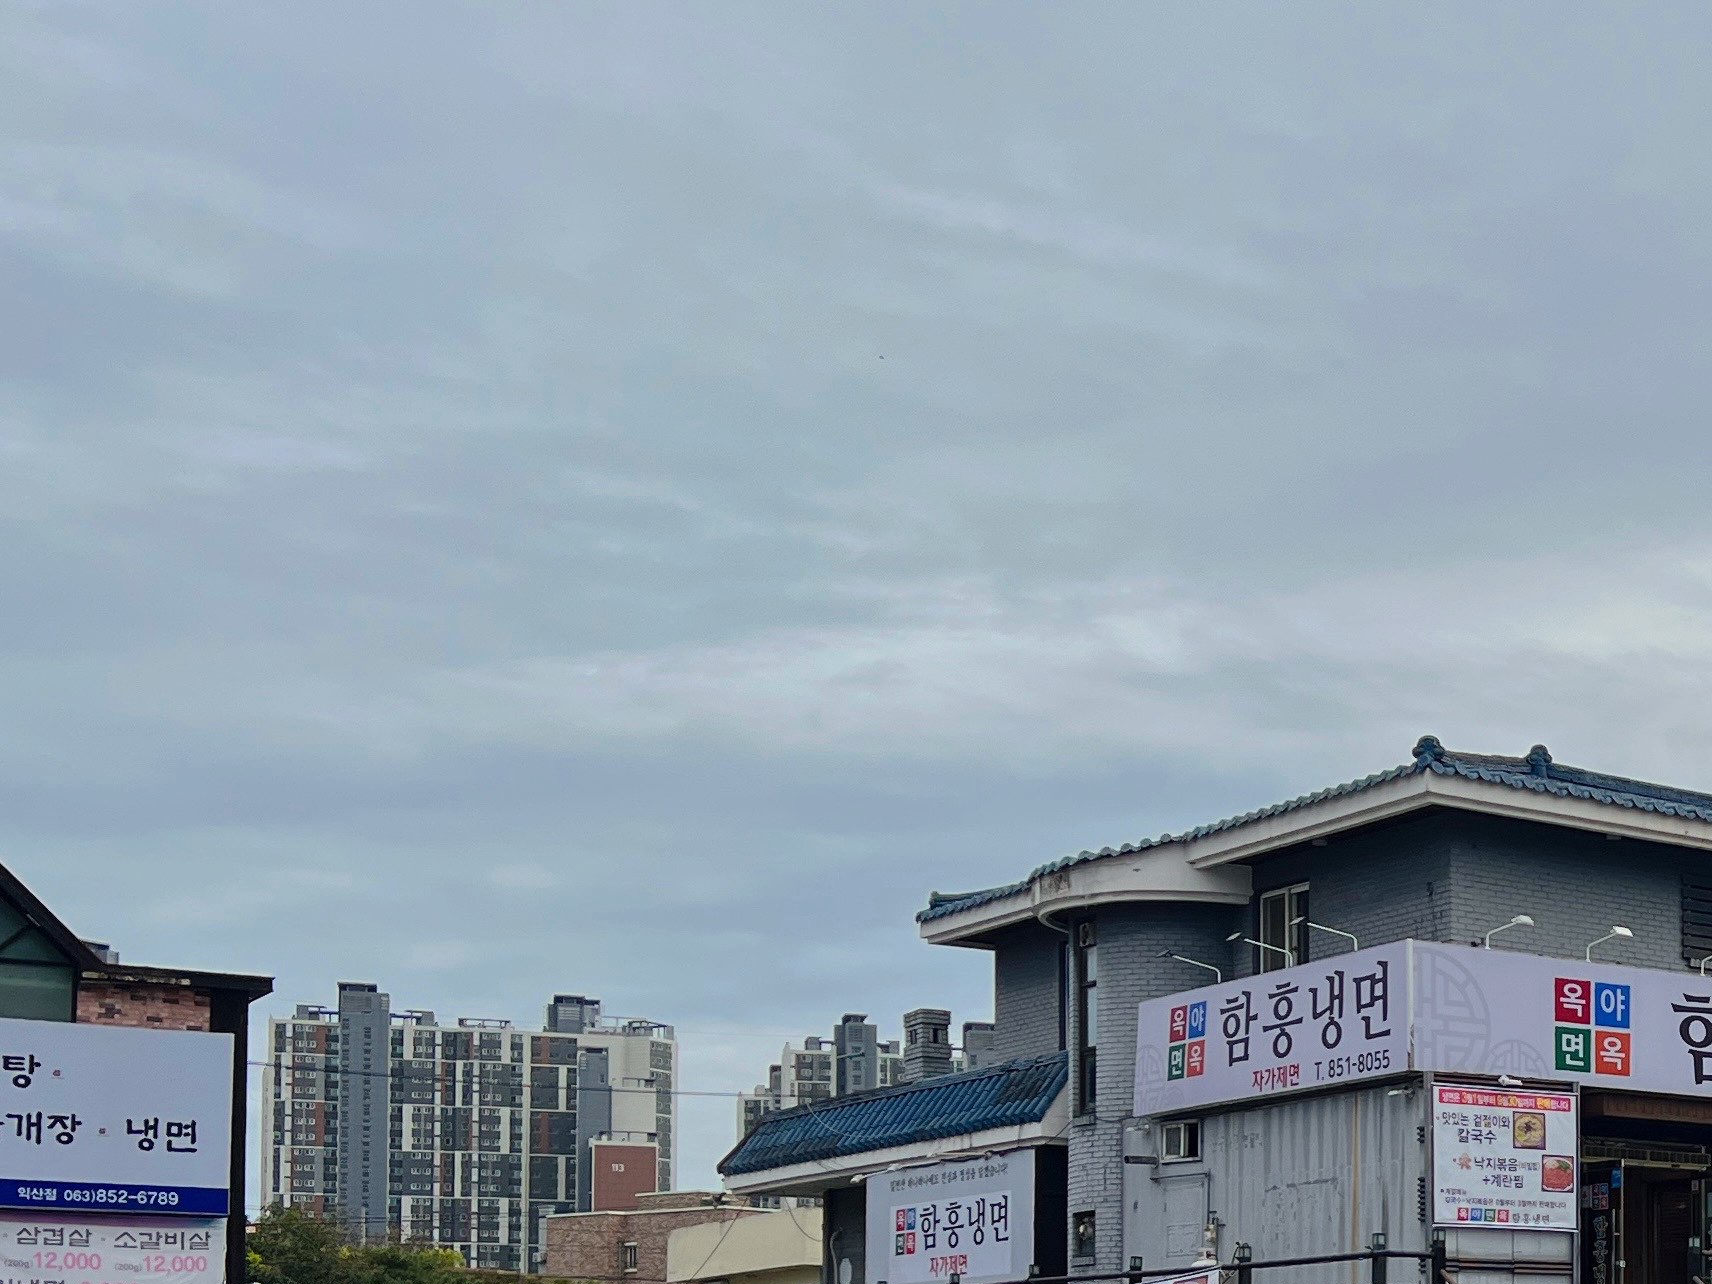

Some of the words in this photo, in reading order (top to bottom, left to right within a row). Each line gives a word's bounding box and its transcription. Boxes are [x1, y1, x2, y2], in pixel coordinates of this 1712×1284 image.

[1220, 960, 1391, 1067] 함흥냉면
[1559, 980, 1628, 1026] 옥야
[1171, 1004, 1205, 1037] 옥야
[1169, 1045, 1204, 1076] 면옥
[1328, 1049, 1391, 1079] 851-8055
[1560, 1031, 1628, 1073] 면옥
[1252, 1063, 1300, 1092] 자가제면
[0, 1111, 82, 1145] 개장
[126, 1117, 198, 1153] 냉면
[1442, 1111, 1469, 1126] 맛있는
[1458, 1128, 1498, 1145] 칼국수
[1474, 1156, 1518, 1171] 낙지볶음
[17, 1187, 57, 1201] 익산점
[63, 1189, 179, 1206] 063)852-6789
[920, 1194, 1009, 1250] 함흥냉면
[16, 1226, 92, 1247] 삼겹살
[114, 1231, 211, 1250] 소갈비살
[33, 1252, 102, 1272] 12,000
[114, 1263, 143, 1273] (200g)
[143, 1254, 208, 1276] 12,000
[930, 1254, 968, 1277] 자가제면
